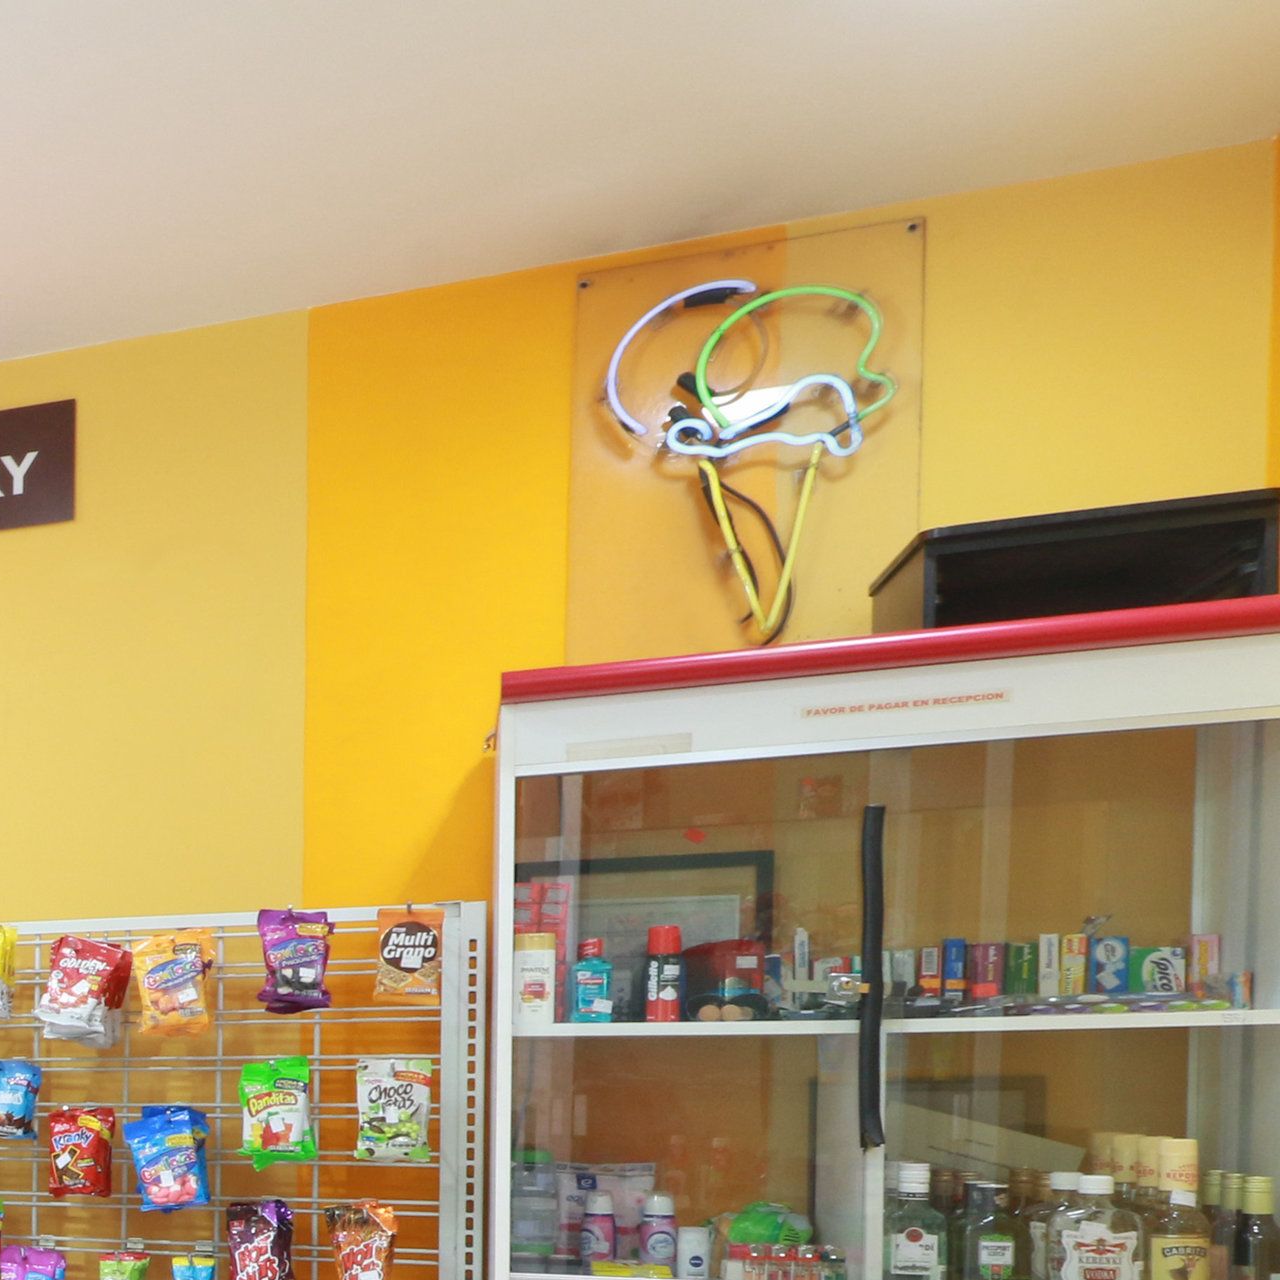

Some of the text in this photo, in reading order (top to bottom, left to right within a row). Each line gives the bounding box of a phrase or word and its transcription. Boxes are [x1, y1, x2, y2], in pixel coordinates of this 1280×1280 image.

[806, 692, 1004, 717] FAVOR DE PAGAR EN RECEPCION
[388, 932, 434, 947] Multi
[382, 944, 437, 960] Grano
[59, 957, 106, 972] GOLDEN
[647, 960, 659, 1002] Gillette
[248, 1090, 297, 1114] Panditas
[369, 1083, 414, 1104] Choco
[53, 1128, 95, 1150] Kranky
[1163, 1245, 1207, 1258] CABRITO
